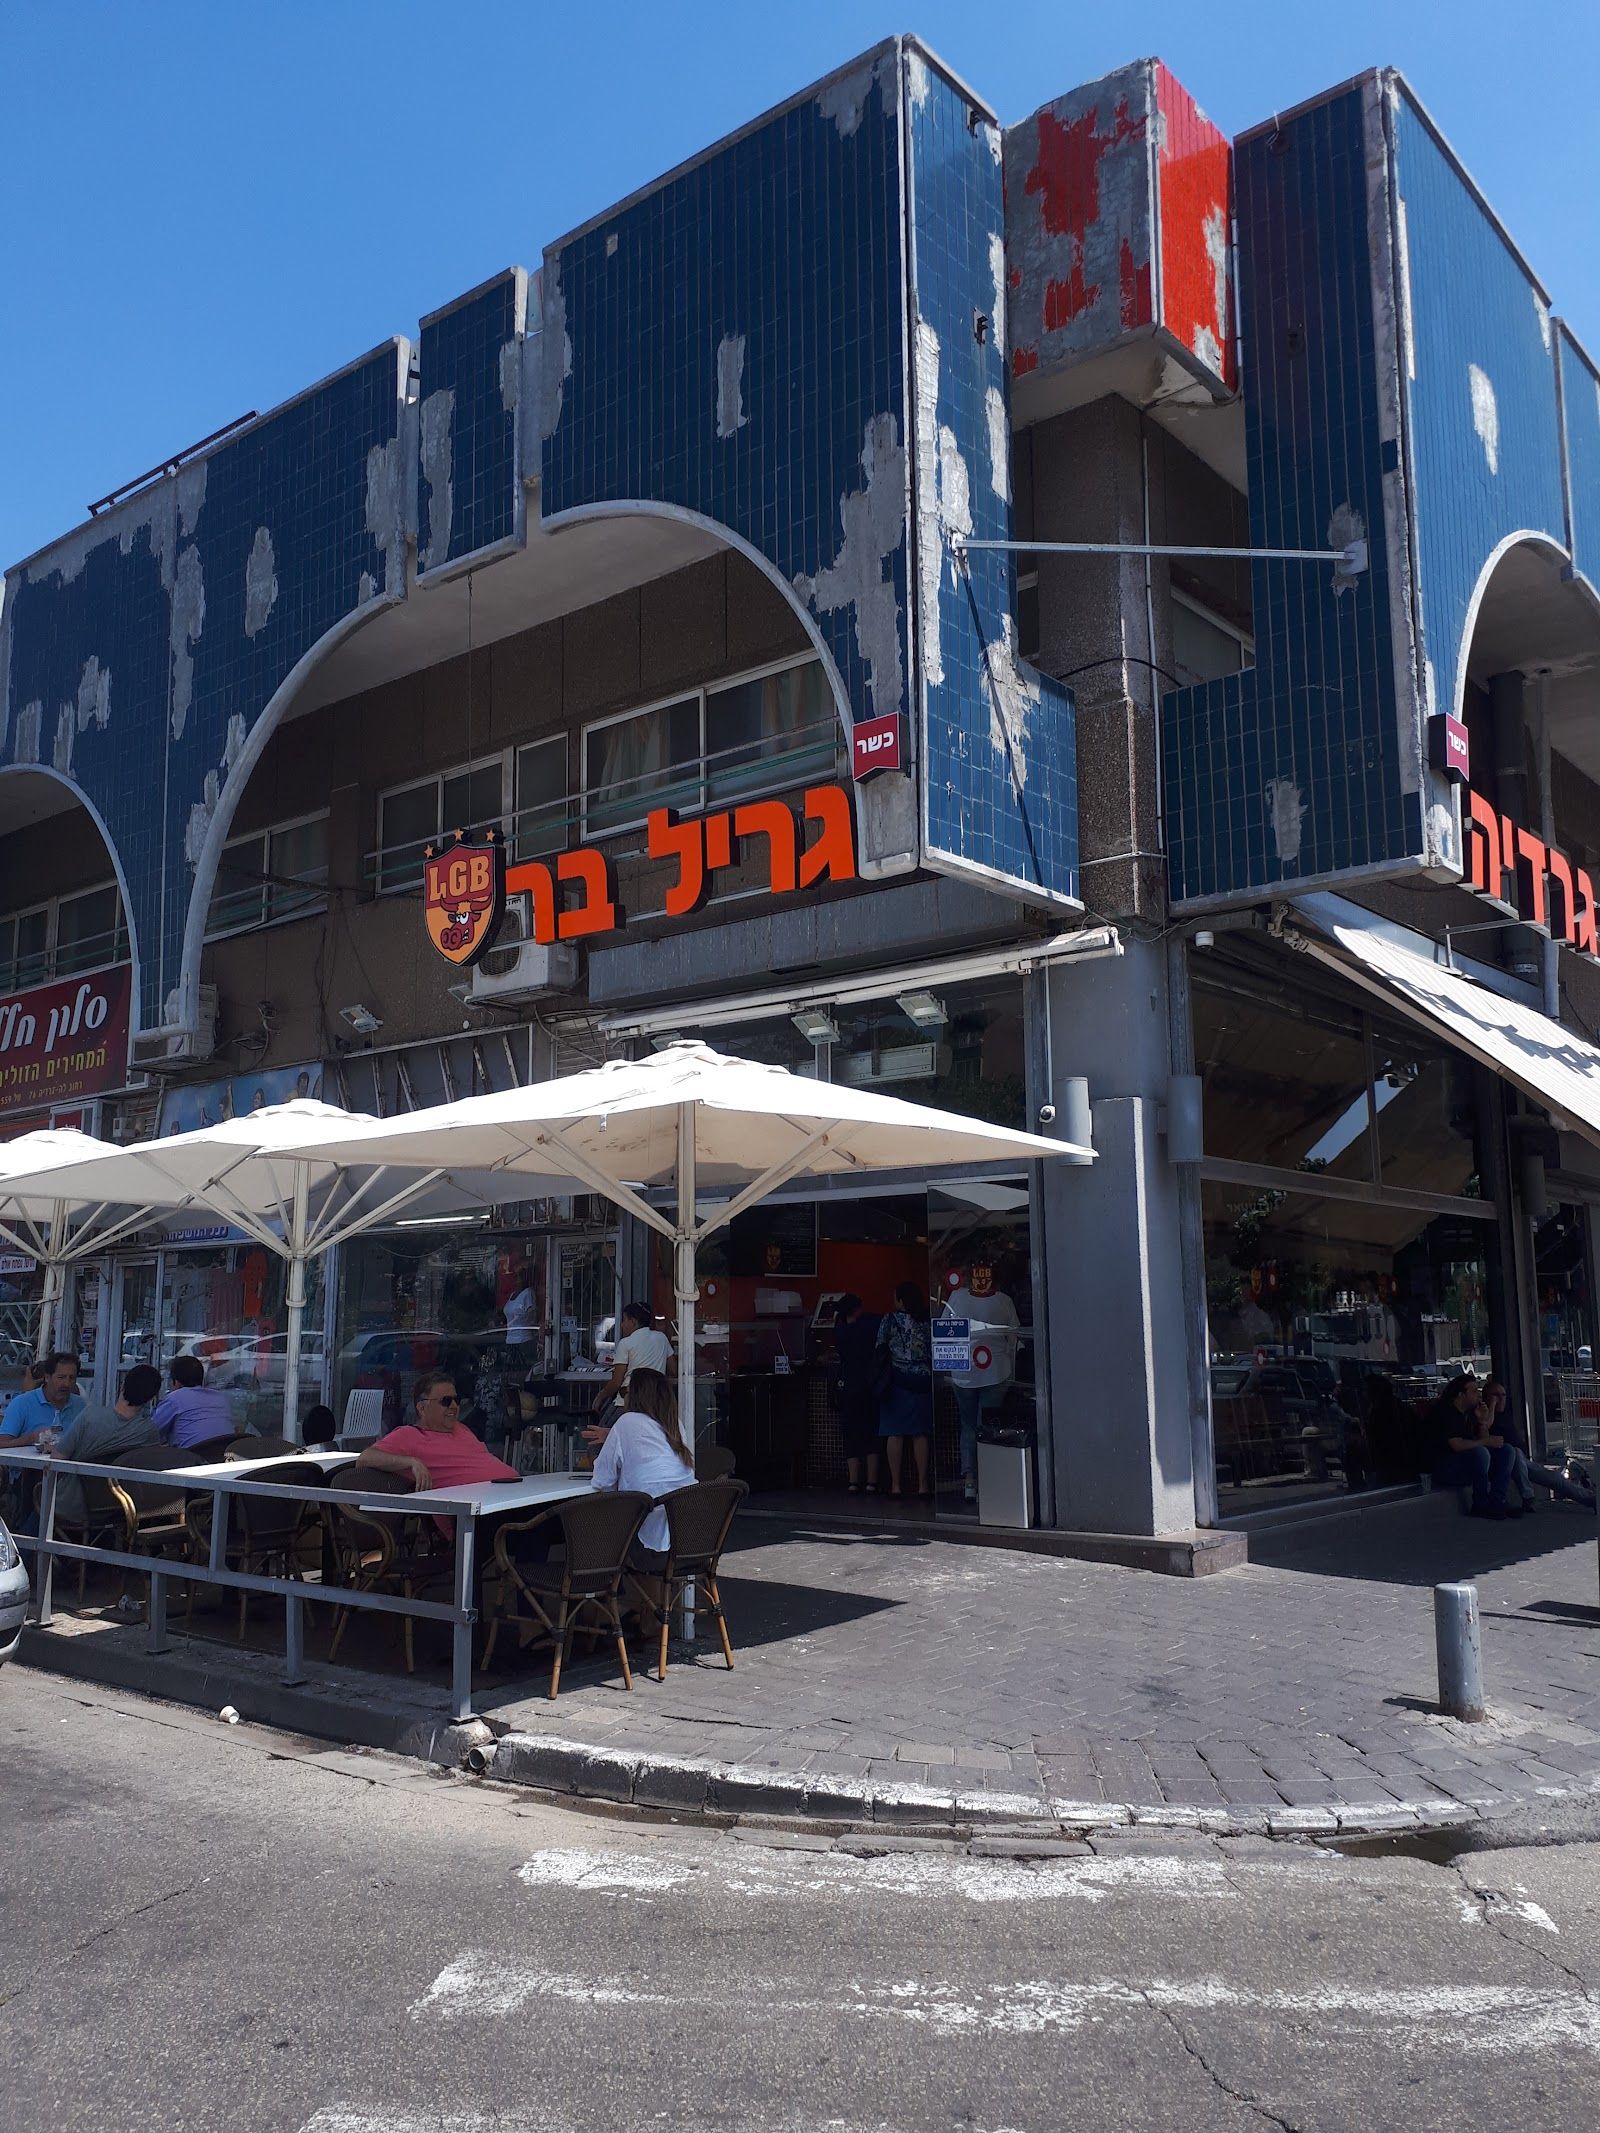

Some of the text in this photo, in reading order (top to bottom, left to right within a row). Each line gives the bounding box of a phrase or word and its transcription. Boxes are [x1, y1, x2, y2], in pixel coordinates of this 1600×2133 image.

[856, 731, 895, 755] כשר
[1447, 730, 1467, 756] כשר
[428, 854, 492, 902] LGB
[505, 785, 857, 946] גריל בר
[1470, 789, 1598, 957] גרדיה
[44, 983, 108, 1053] סלון
[46, 1047, 106, 1078] המחירים
[972, 1268, 992, 1278] LGB
